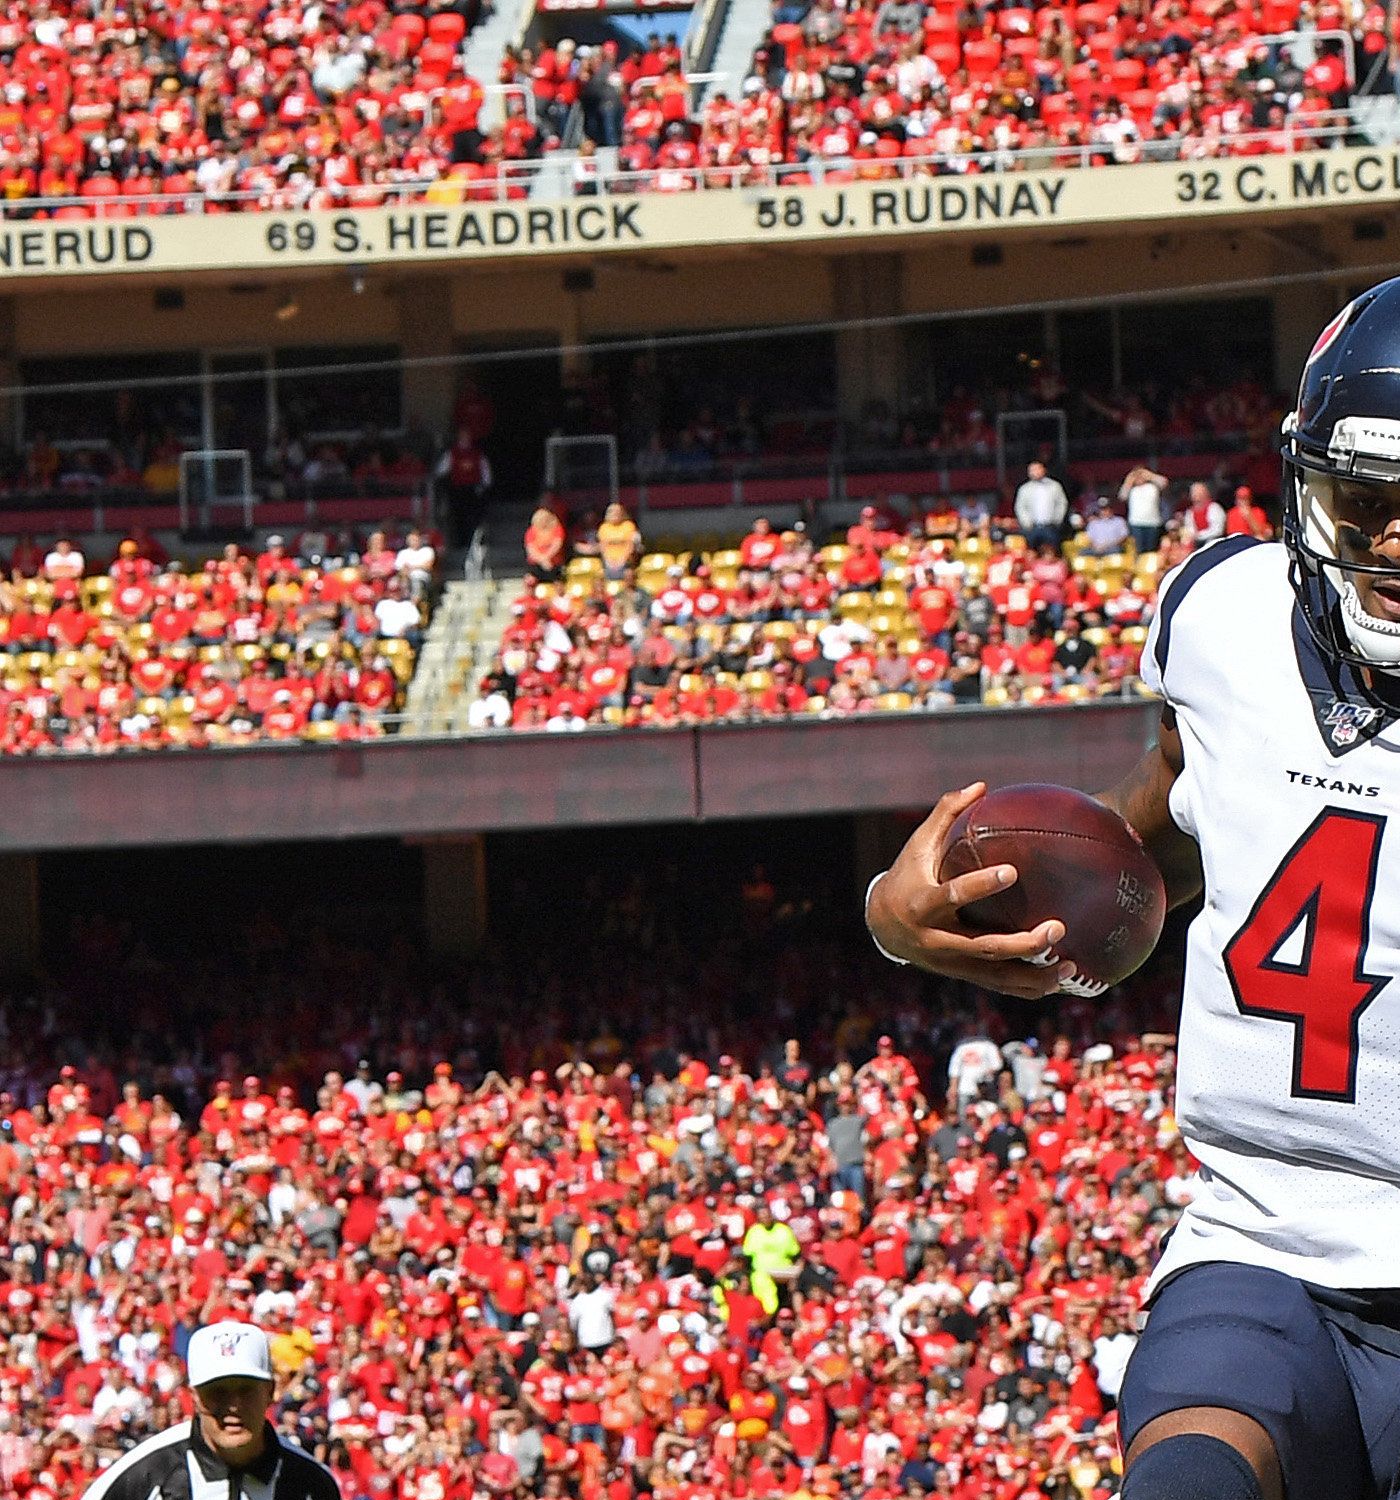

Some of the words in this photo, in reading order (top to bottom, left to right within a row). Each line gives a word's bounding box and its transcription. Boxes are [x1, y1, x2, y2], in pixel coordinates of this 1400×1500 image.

[756, 197, 805, 230] 58
[820, 192, 856, 229] J.
[870, 177, 1067, 227] RUDNAY
[1177, 171, 1222, 205] 32
[1234, 164, 1278, 204] C.
[266, 221, 317, 253] 69
[332, 216, 374, 254] S.
[387, 202, 643, 251] HEADRICK
[1286, 769, 1381, 798] TEXANS
[1221, 804, 1394, 1105] 4
